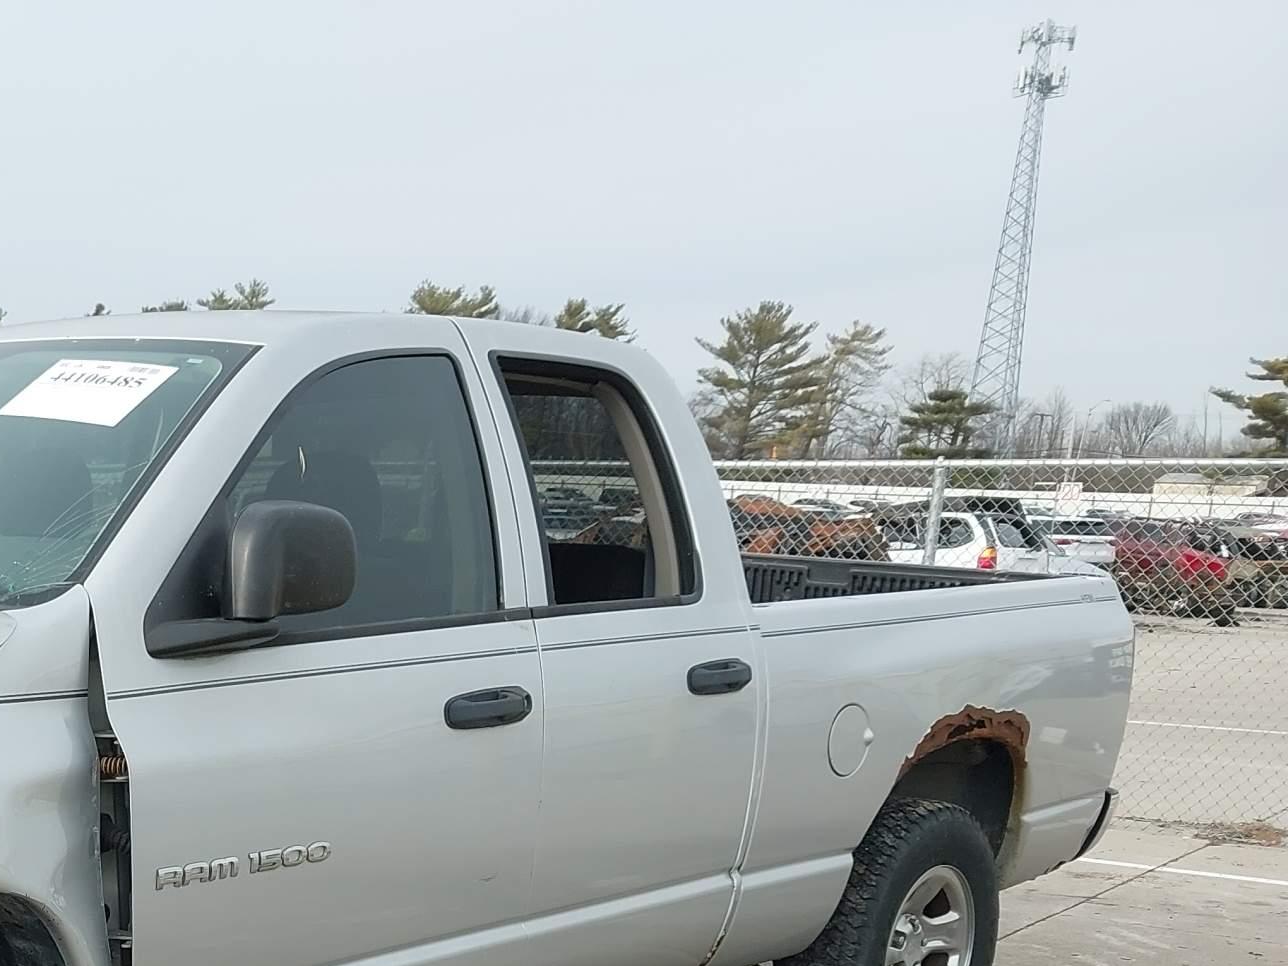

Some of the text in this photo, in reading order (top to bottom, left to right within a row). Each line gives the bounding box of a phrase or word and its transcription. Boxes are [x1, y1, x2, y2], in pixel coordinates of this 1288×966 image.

[50, 372, 148, 388] 44106485
[155, 841, 332, 891] RAM 1500
